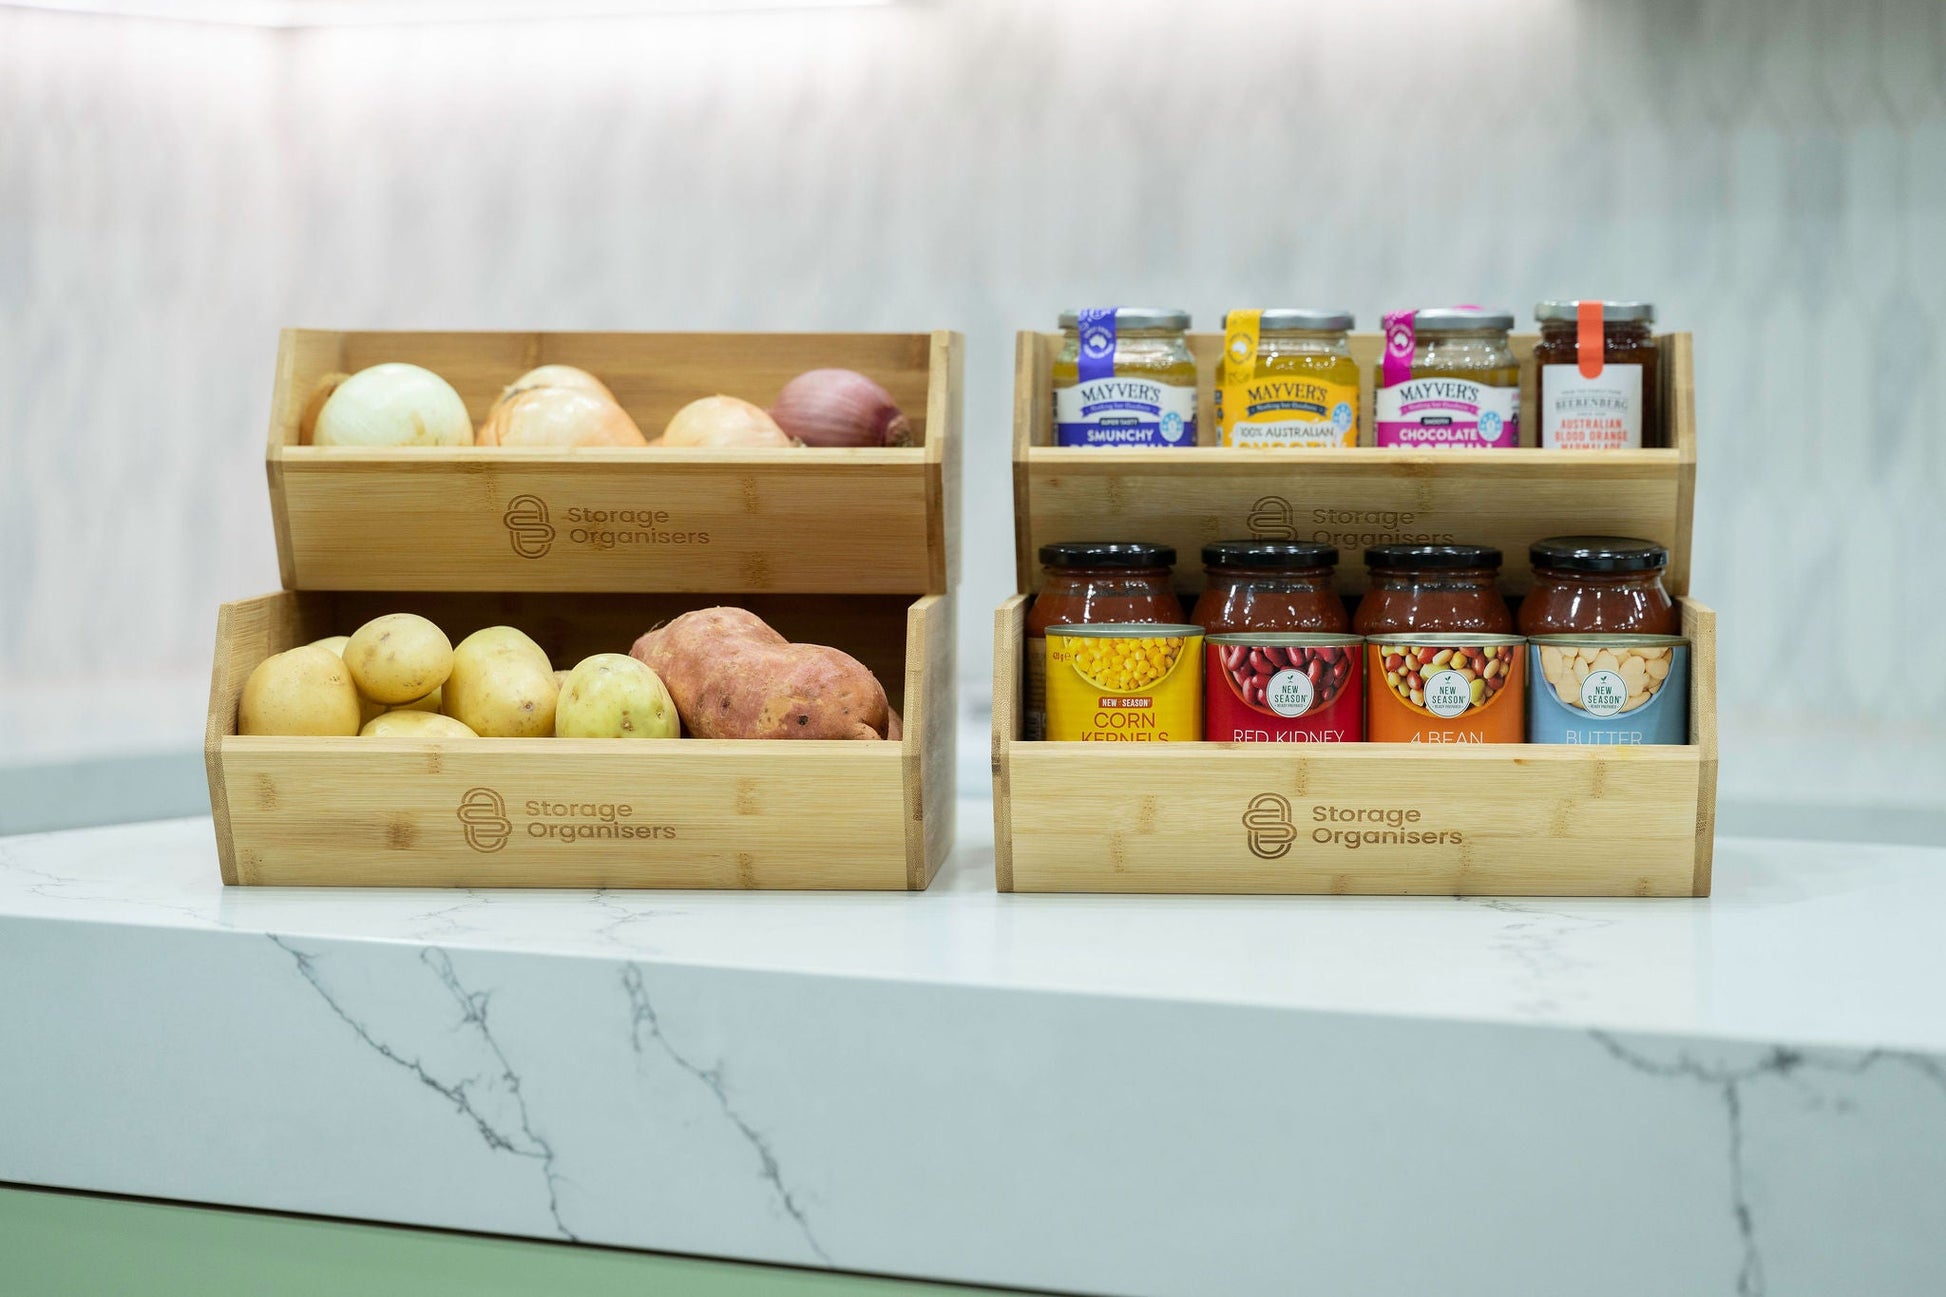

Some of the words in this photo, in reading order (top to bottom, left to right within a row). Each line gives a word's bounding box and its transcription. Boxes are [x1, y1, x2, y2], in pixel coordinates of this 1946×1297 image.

[1561, 419, 1623, 429] AUSTRALIAN
[1087, 429, 1154, 442] SMUNCHY
[1265, 427, 1335, 438] AUSTRALIAN
[1400, 428, 1477, 441] CHOCOLATE
[1554, 431, 1586, 442] BLOOD
[1589, 430, 1629, 442] ORANGE
[568, 507, 670, 529] Storage
[1312, 508, 1415, 530] Storage
[569, 528, 711, 549] Organisers
[1312, 529, 1455, 550] Organisers
[1281, 685, 1299, 694] NEW
[1439, 686, 1457, 695] NEW
[1595, 686, 1613, 695] NEW
[1102, 698, 1117, 707] NEW
[1094, 712, 1155, 729] CORN
[1233, 729, 1269, 743] RED
[1276, 730, 1345, 743] KIDNEY
[1410, 731, 1421, 744] 4
[1428, 731, 1484, 744] BEAN
[1566, 730, 1643, 745] BUTTER
[525, 800, 633, 822] Storage
[1312, 805, 1421, 827] Storage
[527, 821, 677, 843] Organisers
[1311, 827, 1463, 849] Organisers
